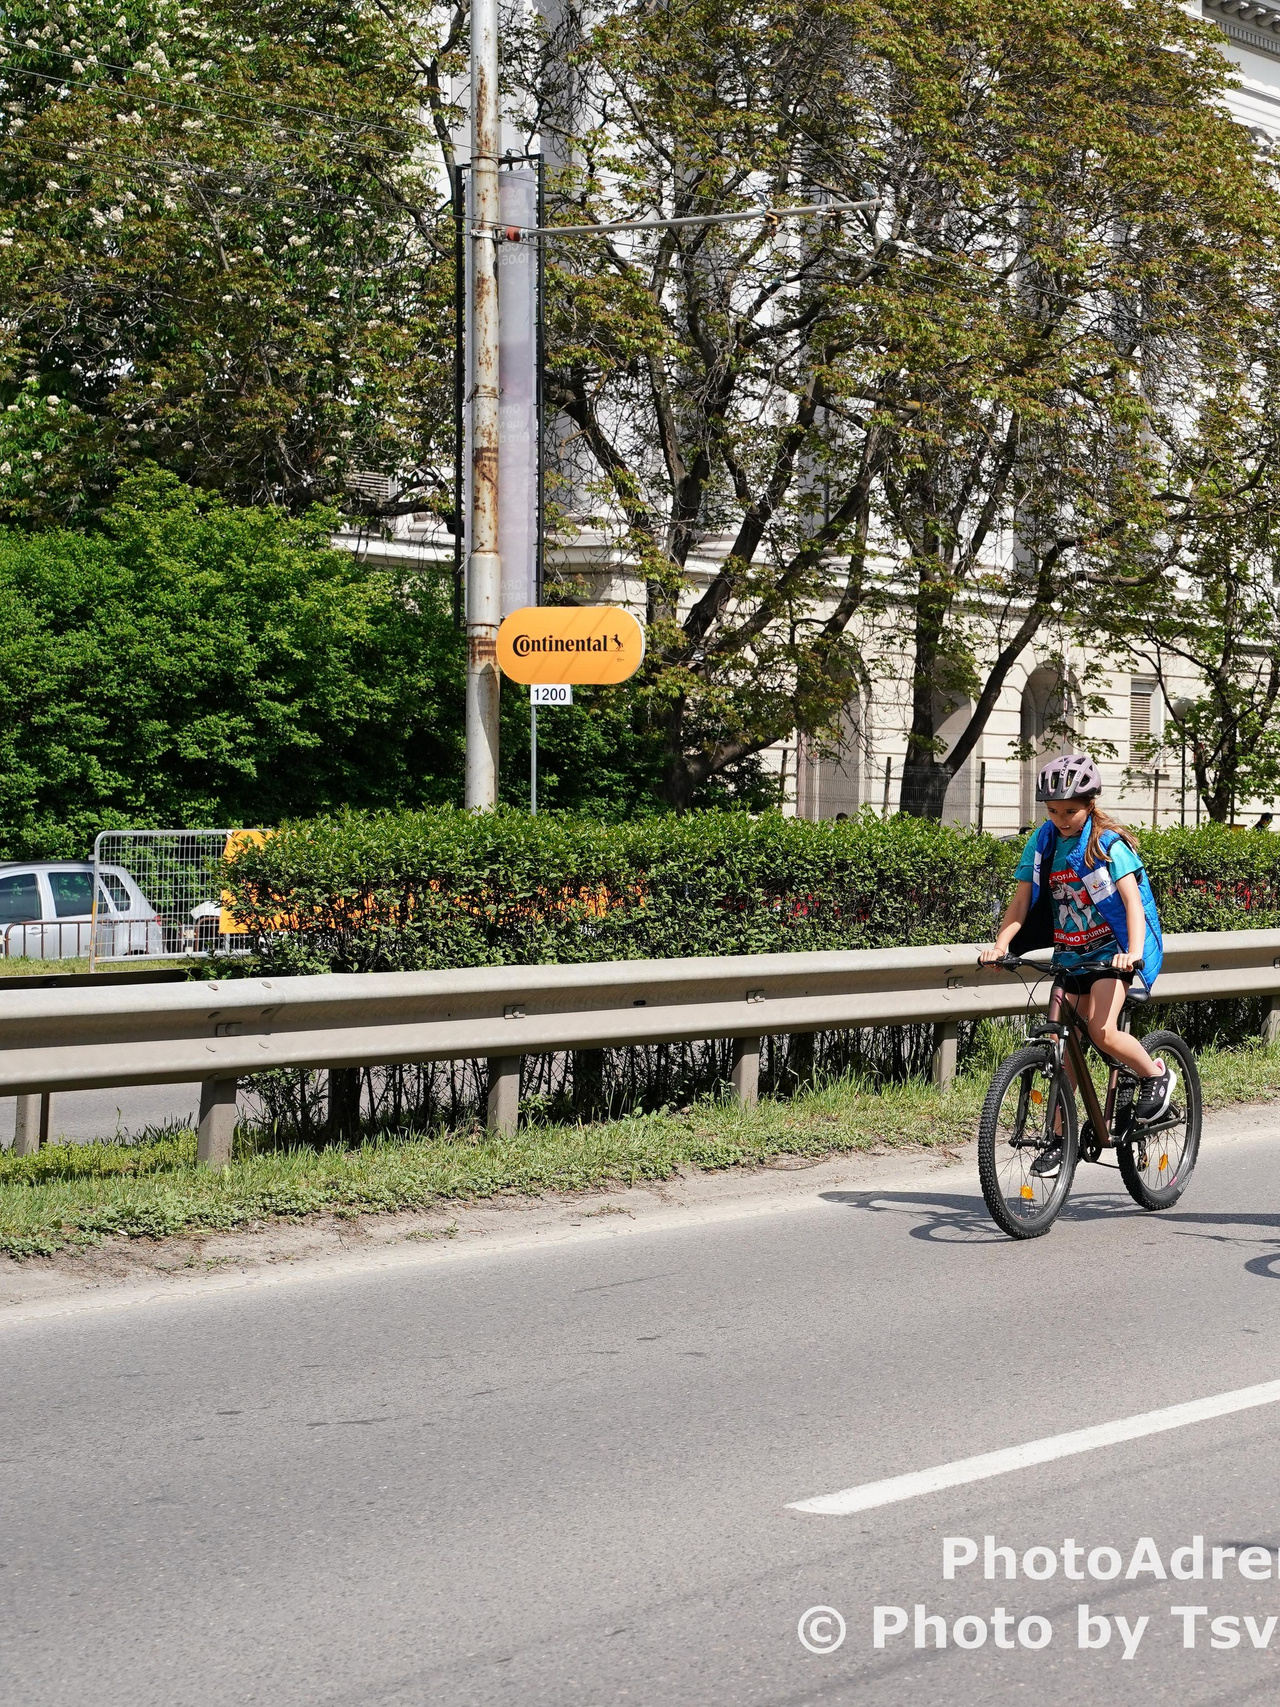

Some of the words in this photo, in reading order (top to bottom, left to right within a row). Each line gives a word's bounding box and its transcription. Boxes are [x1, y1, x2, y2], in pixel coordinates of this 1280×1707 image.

[512, 634, 608, 657] Continental
[534, 688, 567, 701] 1200
[1081, 925, 1111, 941] TOURNA
